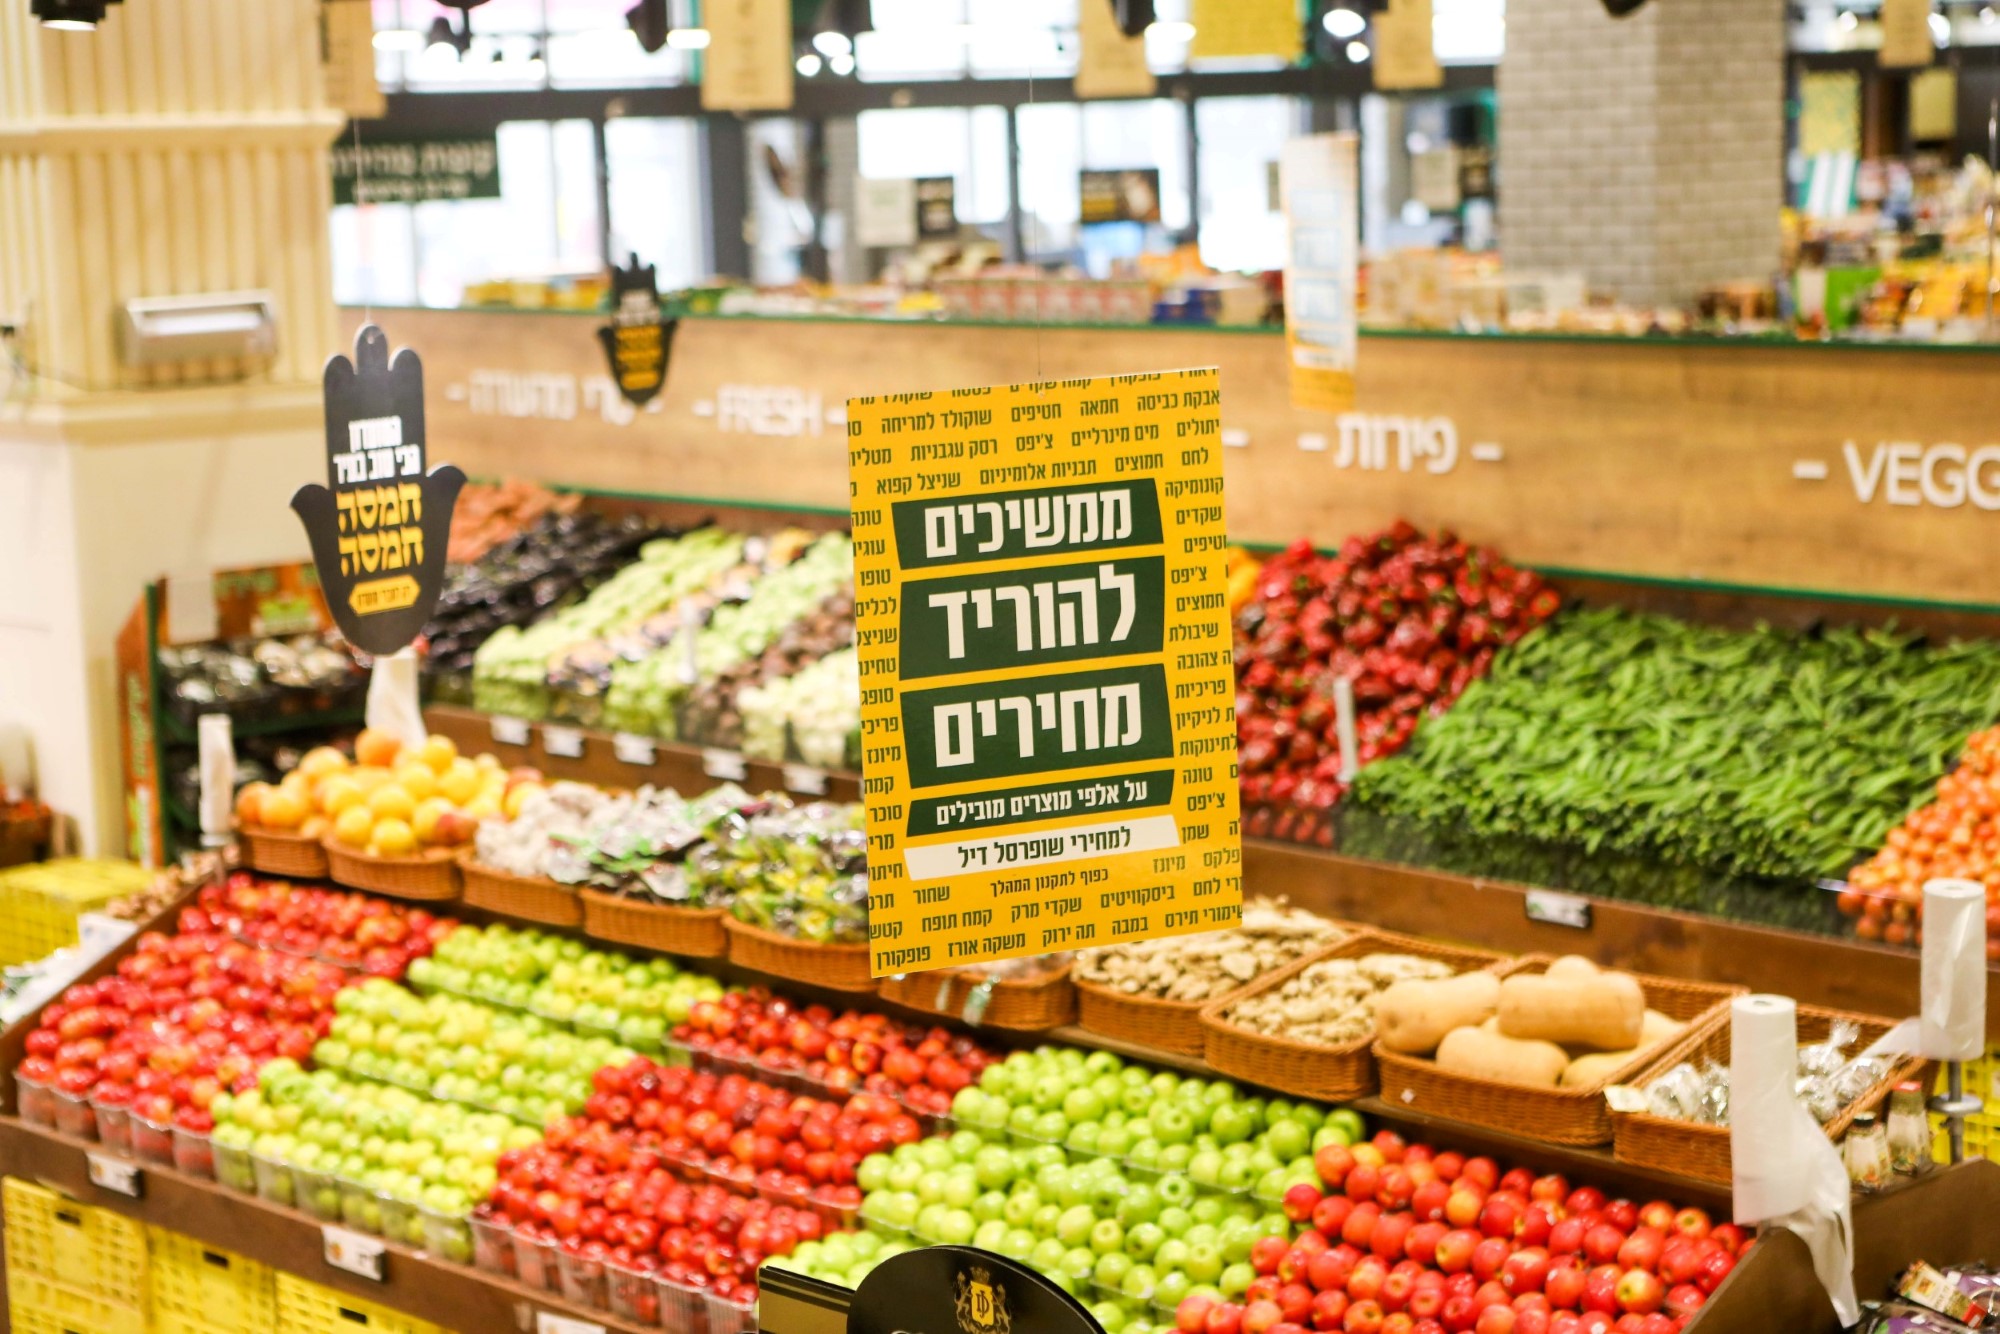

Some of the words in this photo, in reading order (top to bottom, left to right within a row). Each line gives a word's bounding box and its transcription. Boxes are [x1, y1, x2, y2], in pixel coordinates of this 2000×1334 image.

[1081, 399, 1118, 416] חמאה
[1138, 394, 1178, 411] כביסה
[1184, 390, 1219, 409] אבקת
[717, 384, 824, 437] FRESH
[940, 410, 991, 429] שוקולד
[1012, 404, 1061, 422] חטיפים
[882, 412, 934, 433] למריחה
[1177, 419, 1219, 437] יתולים
[1072, 427, 1129, 446] מינרליים
[1135, 425, 1158, 440] מים
[911, 442, 963, 461] עגבניות
[969, 439, 997, 459] רסק
[1016, 434, 1053, 451] צ'יפס
[1334, 413, 1459, 474] פירות
[851, 448, 891, 466] מטליו
[1115, 454, 1163, 472] חמוצים
[1182, 447, 1208, 465] לחם
[980, 463, 1046, 484] אלומיניום
[1052, 460, 1096, 478] תבניות
[1842, 440, 2000, 510] VEGG
[877, 477, 912, 495] קפוא
[917, 473, 960, 490] שניצל
[1165, 477, 1223, 498] קונומיקה
[335, 481, 423, 533] חמסה
[1176, 506, 1221, 525] שקדים
[850, 510, 881, 529] טונה
[925, 490, 1131, 557] ממשיכים
[337, 525, 425, 577] חמסה
[1184, 535, 1227, 553] טיפים
[860, 569, 890, 586] טופו
[1171, 567, 1206, 584] צ'יפס
[855, 597, 897, 618] לכלים
[929, 565, 1135, 658] להוריד
[1176, 593, 1224, 612] חמוצים
[1169, 623, 1218, 642] שיבולת
[1178, 652, 1217, 670] צהובה
[862, 688, 893, 705] סופג
[1176, 680, 1226, 699] פריכיות
[860, 717, 898, 737] פריכי
[934, 683, 1141, 767] מחירים
[1176, 707, 1220, 730] לניקיון
[867, 746, 901, 764] מיונז
[1183, 767, 1212, 784] טונה
[1078, 784, 1119, 806] אלפי
[1125, 781, 1146, 801] על
[1011, 791, 1071, 815] מוצרים
[1187, 793, 1225, 811] צ'יפס
[870, 805, 902, 822] סוכר
[937, 799, 1004, 825] מובילים
[1071, 826, 1130, 852] למחירי
[1182, 824, 1209, 843] שמן
[958, 847, 987, 867] דיל
[994, 837, 1063, 863] שופרסל
[867, 863, 902, 881] חיתו
[1153, 856, 1185, 873] מיונז
[1036, 871, 1075, 891] לתקנון
[1080, 869, 1108, 885] כפוף
[913, 886, 950, 904] שחור
[990, 878, 1030, 897] המהלך
[1101, 885, 1175, 908] ביסקוויטים
[1194, 878, 1220, 896] לחם
[1011, 903, 1039, 923] מרק
[1045, 898, 1082, 916] שקדי
[922, 914, 957, 932] תופח
[962, 909, 992, 927] קמח
[1112, 917, 1148, 935] במבה
[1165, 910, 1198, 928] תירס
[1042, 927, 1072, 948] ירוק
[1076, 924, 1095, 940] תה
[948, 939, 978, 957] אורז
[983, 933, 1025, 954] משקה
[877, 946, 931, 970] פופקורן
